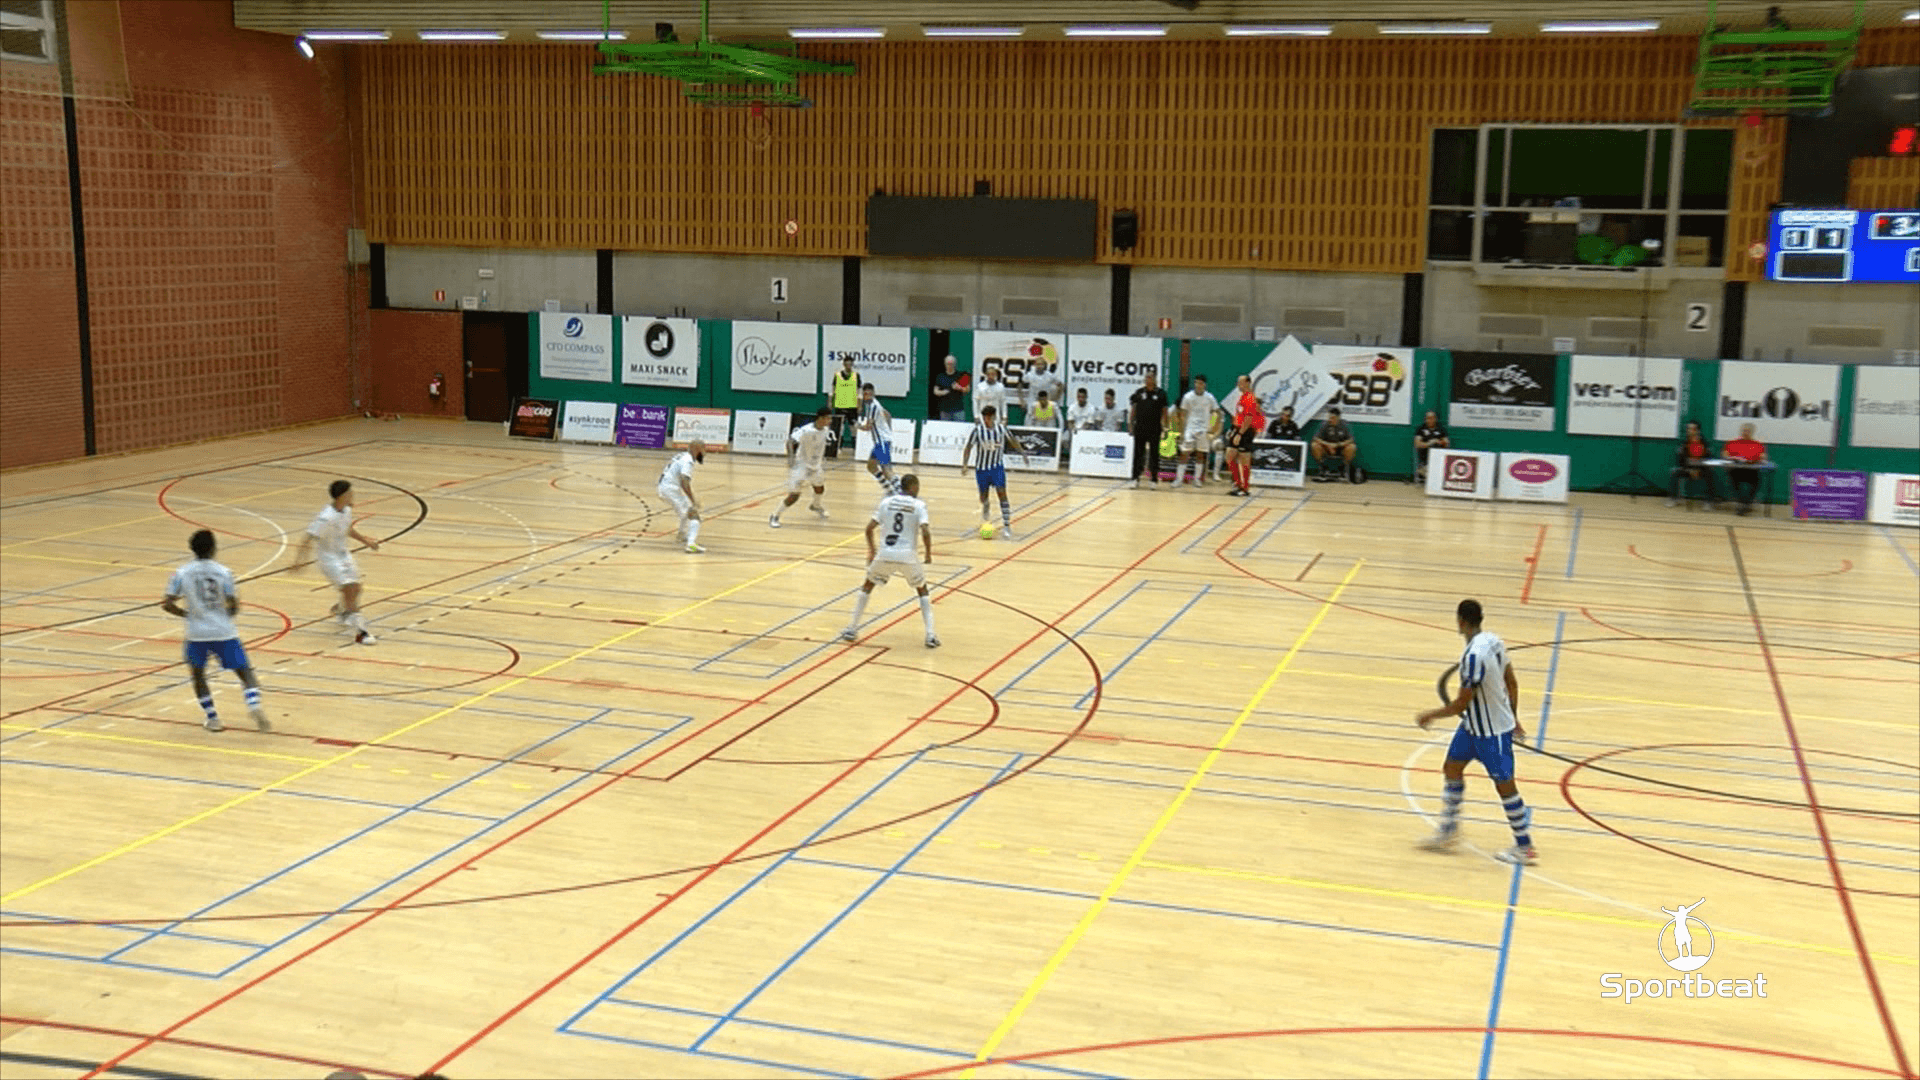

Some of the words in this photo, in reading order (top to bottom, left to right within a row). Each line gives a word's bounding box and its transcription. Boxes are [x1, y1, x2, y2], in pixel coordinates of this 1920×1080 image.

[1786, 231, 1801, 247] 1
[1826, 230, 1841, 247] 1
[773, 279, 786, 301] 1
[1688, 305, 1707, 330] 2
[564, 343, 605, 355] COMPASS
[836, 348, 907, 364] synkroon
[630, 363, 654, 375] MAXI
[657, 364, 688, 377] SNACK
[1071, 359, 1158, 376] ver-com
[1573, 382, 1676, 401] ver-com
[892, 512, 905, 534] 8
